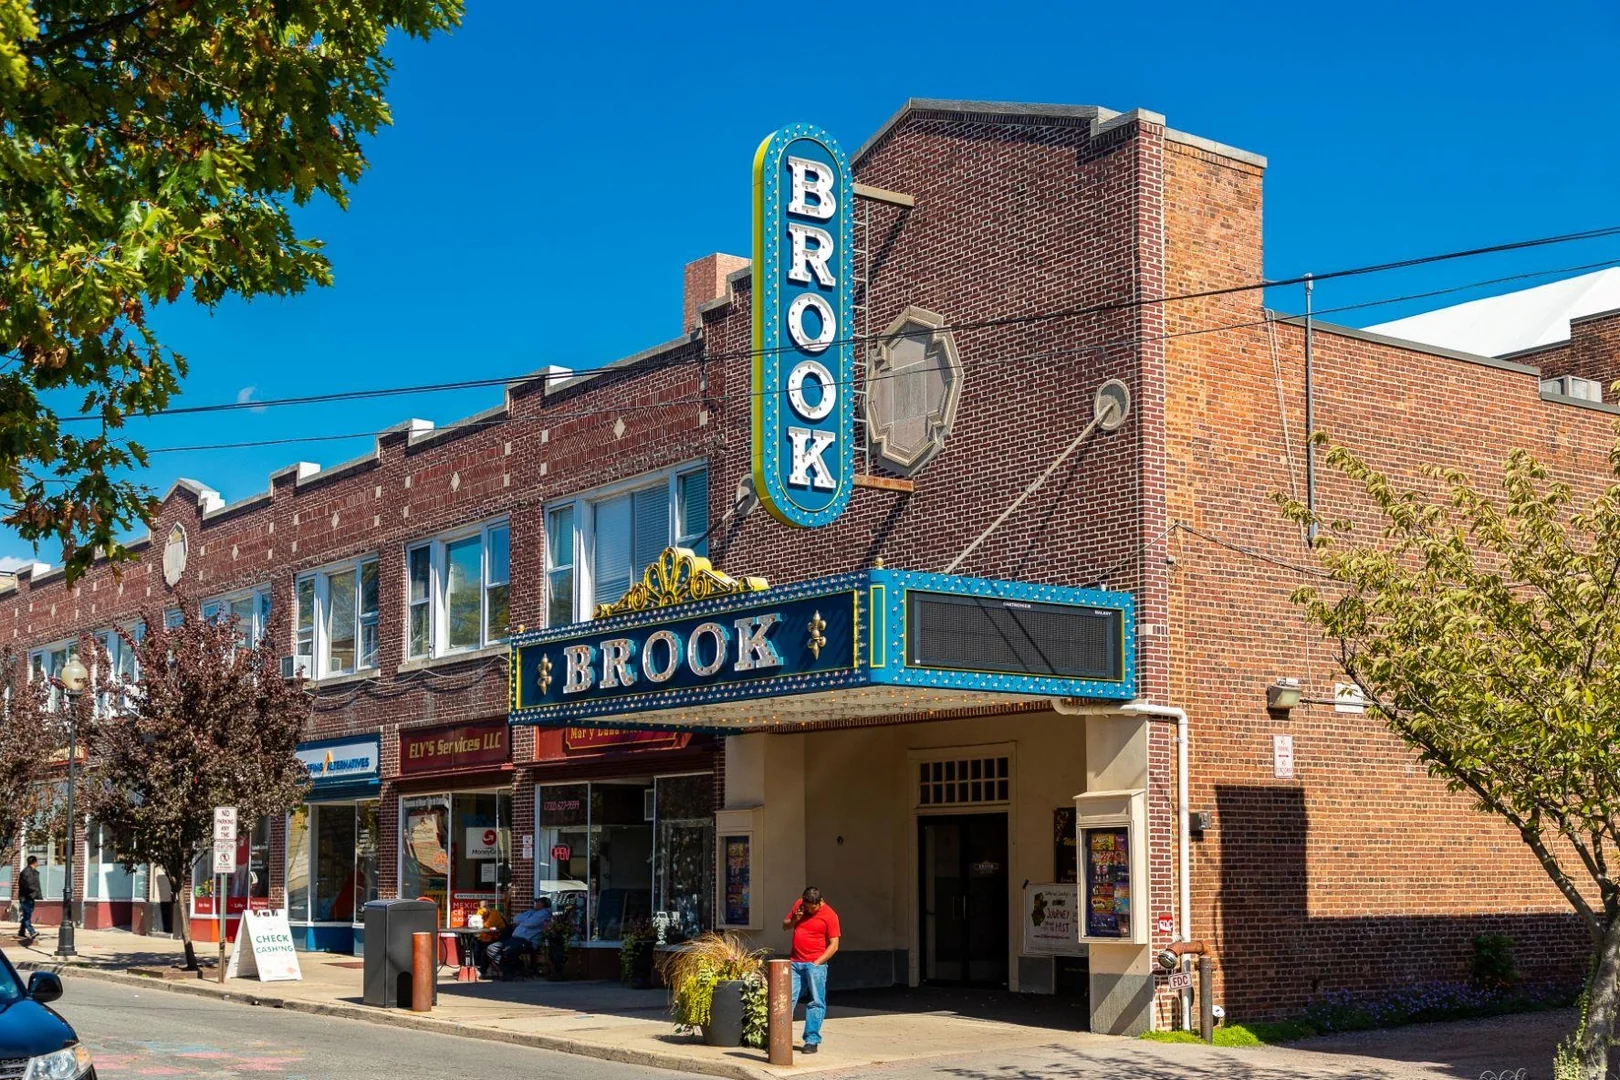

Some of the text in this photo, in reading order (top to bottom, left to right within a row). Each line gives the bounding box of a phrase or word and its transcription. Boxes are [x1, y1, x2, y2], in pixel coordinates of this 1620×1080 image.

[786, 155, 837, 489] BROOK
[563, 613, 783, 694] BROOK
[409, 732, 502, 759] ELY'S Services LLC
[551, 846, 571, 860] OPEN
[256, 934, 290, 944] CHECK
[256, 945, 294, 955] CASHING
[1172, 975, 1189, 988] FDC
